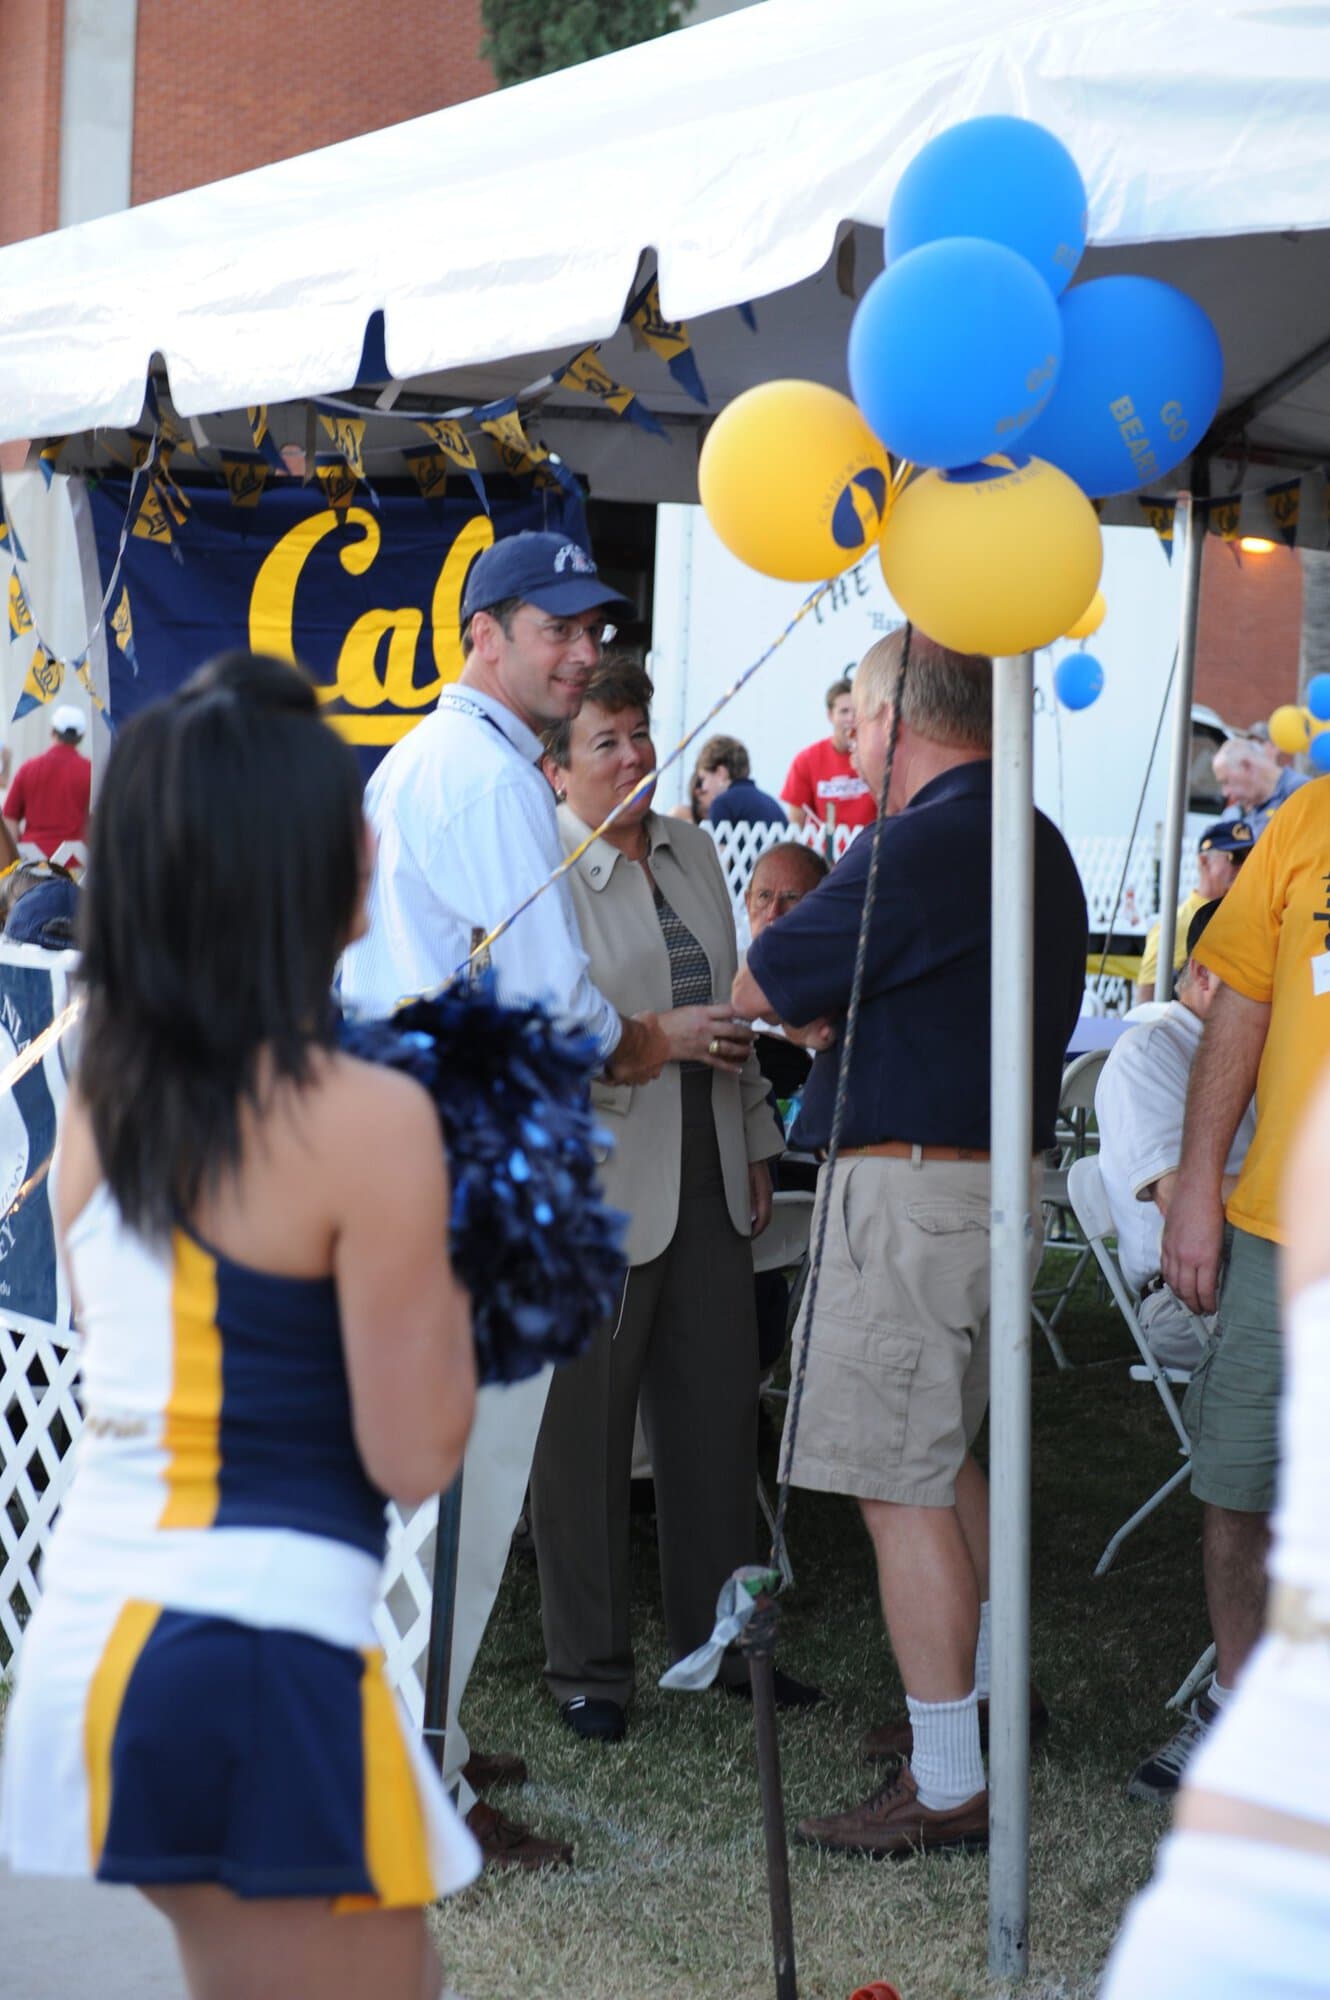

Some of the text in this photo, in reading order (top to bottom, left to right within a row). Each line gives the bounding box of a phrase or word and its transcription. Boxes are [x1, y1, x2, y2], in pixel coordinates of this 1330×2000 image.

[1109, 394, 1159, 481] BEARS
[1159, 400, 1189, 443] GO
[248, 507, 494, 709] Cal
